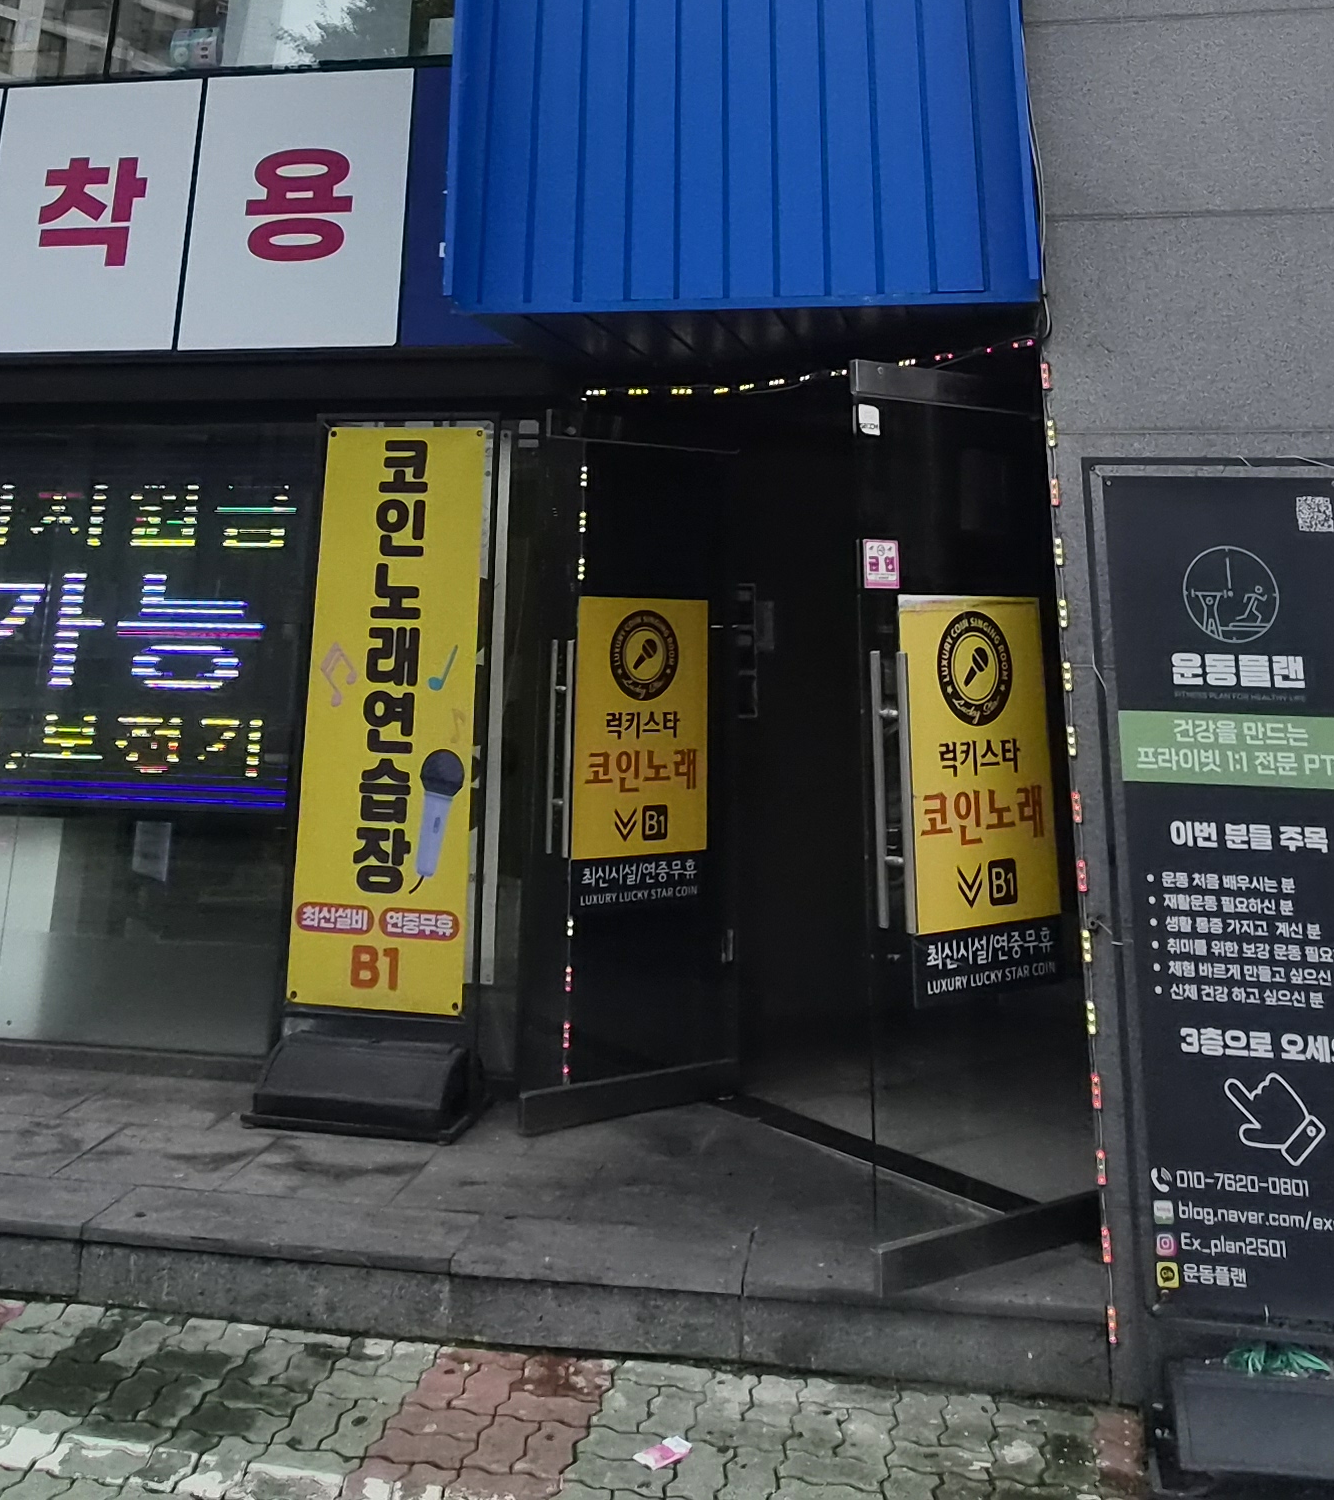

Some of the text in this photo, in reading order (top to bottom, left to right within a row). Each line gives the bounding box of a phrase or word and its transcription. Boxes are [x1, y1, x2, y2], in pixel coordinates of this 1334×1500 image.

[352, 438, 430, 894] 코인노래연습장
[605, 711, 680, 740] 럭키스타
[1174, 719, 1309, 747] 건강을 만드는
[584, 749, 697, 792] 코인노래
[938, 738, 1021, 778] 럭키스타
[1136, 747, 1221, 773] 프라이빗
[1254, 751, 1298, 776] 전문
[920, 784, 1045, 846] 코인노래
[1224, 823, 1273, 851] 분들
[1279, 825, 1329, 853] 주목
[580, 885, 698, 906] LUXURY LUCKY STAR COIN
[991, 866, 1015, 899] B1
[1162, 871, 1278, 893] 운동 처음 배우시는
[1220, 896, 1277, 916] 필요하신
[301, 905, 454, 937] 최신설비 연중무휴
[1227, 919, 1304, 939] 가지고 계신
[1211, 940, 1239, 958] 위한
[1273, 943, 1302, 961] 운동
[350, 945, 399, 992] B1
[927, 961, 1056, 995] LUXURY LUCKY STAR COIN
[1198, 962, 1332, 987] 바르게 만들고 싶으신
[1170, 983, 1307, 1008] 신체 건강 하고 싶으신
[1179, 1027, 1275, 1059] 3층으로
[1176, 1169, 1310, 1197] 010-7620-0801
[1180, 1232, 1288, 1259] Ex_plan2501
[1183, 1263, 1248, 1288] 운동플랜
